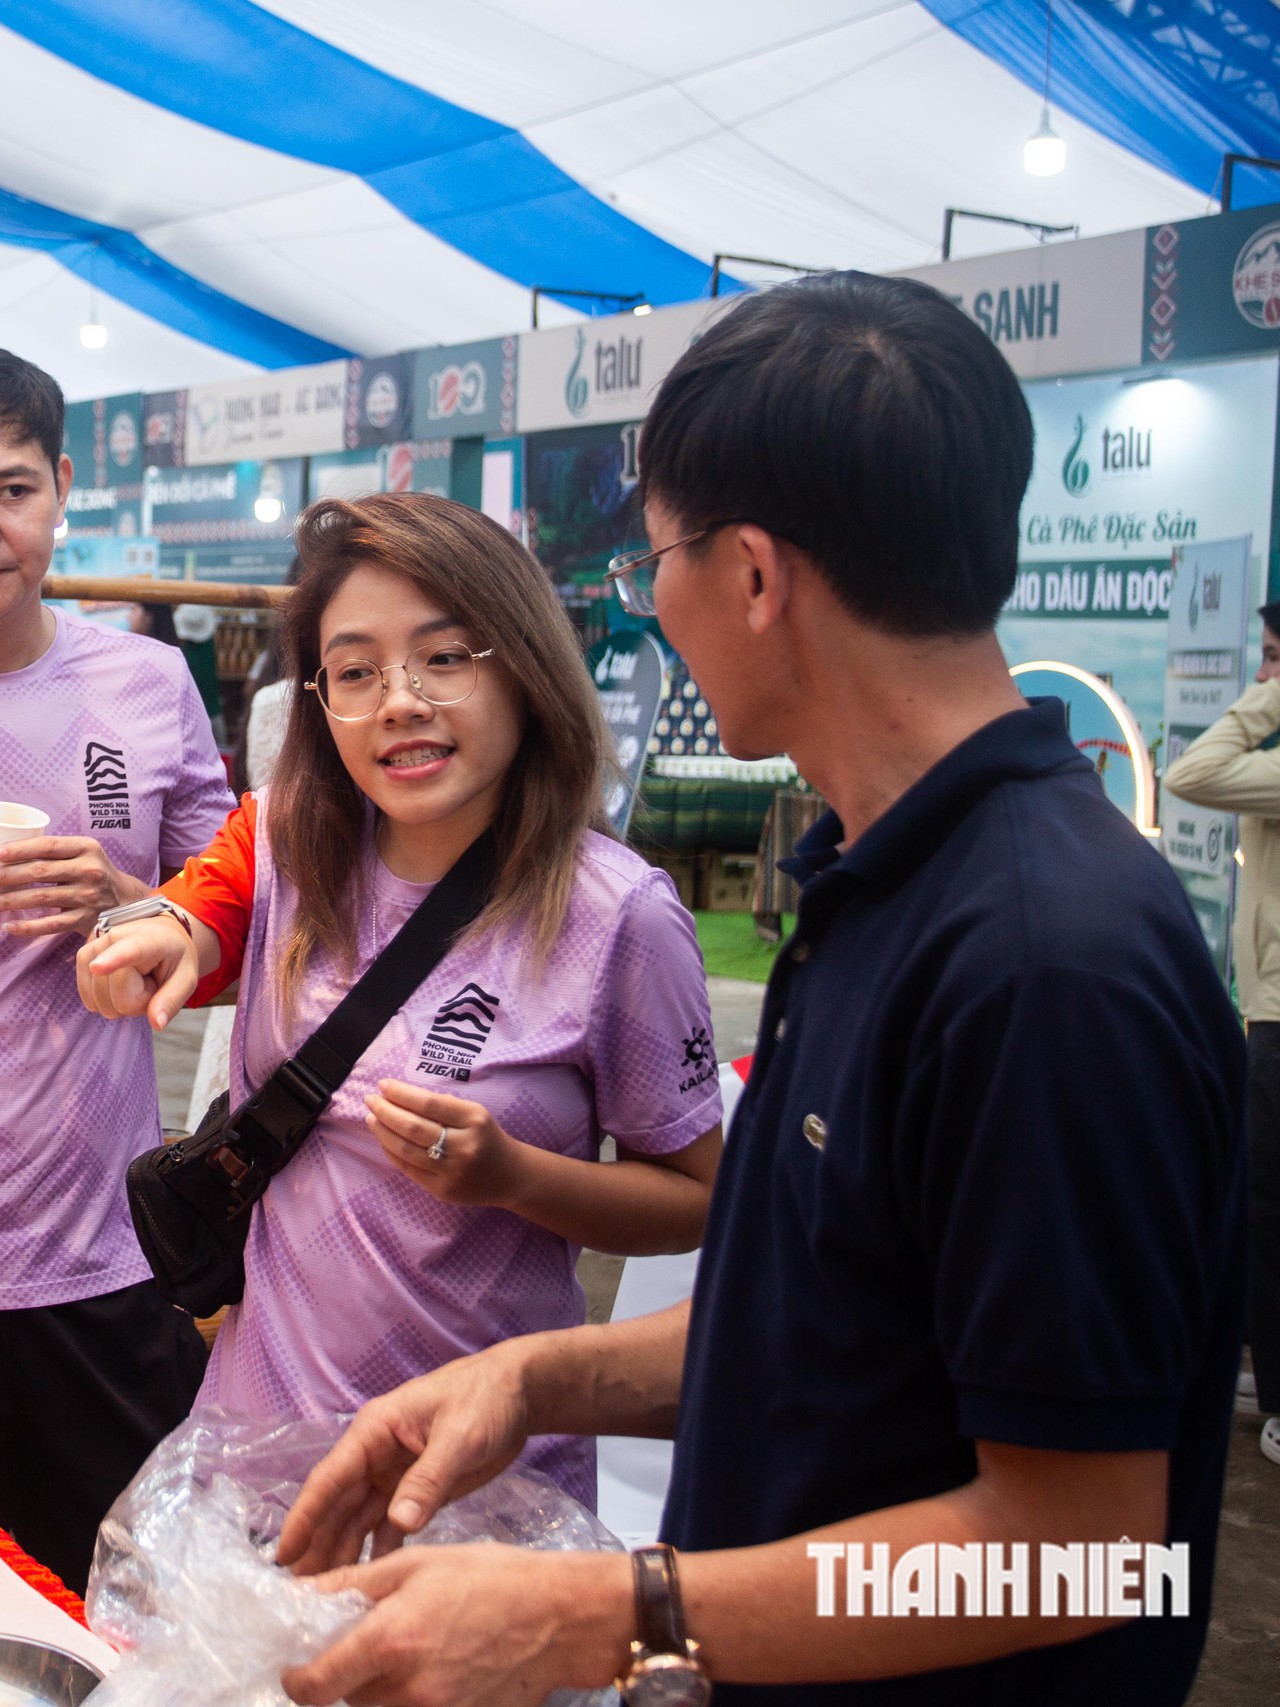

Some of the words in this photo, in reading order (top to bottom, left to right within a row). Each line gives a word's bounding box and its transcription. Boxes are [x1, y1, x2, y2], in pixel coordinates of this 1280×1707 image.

[973, 278, 1060, 343] SANH
[1026, 514, 1053, 545] Cà
[1058, 510, 1099, 544] Phê
[1103, 510, 1147, 551] Đặc
[1152, 508, 1198, 541] Sản
[1008, 571, 1041, 612] HO
[90, 819, 122, 829] FUGA
[422, 1040, 455, 1055] PHONG
[421, 1048, 445, 1060] WILD
[446, 1054, 473, 1066] TRAIL
[415, 1061, 457, 1079] FUGA
